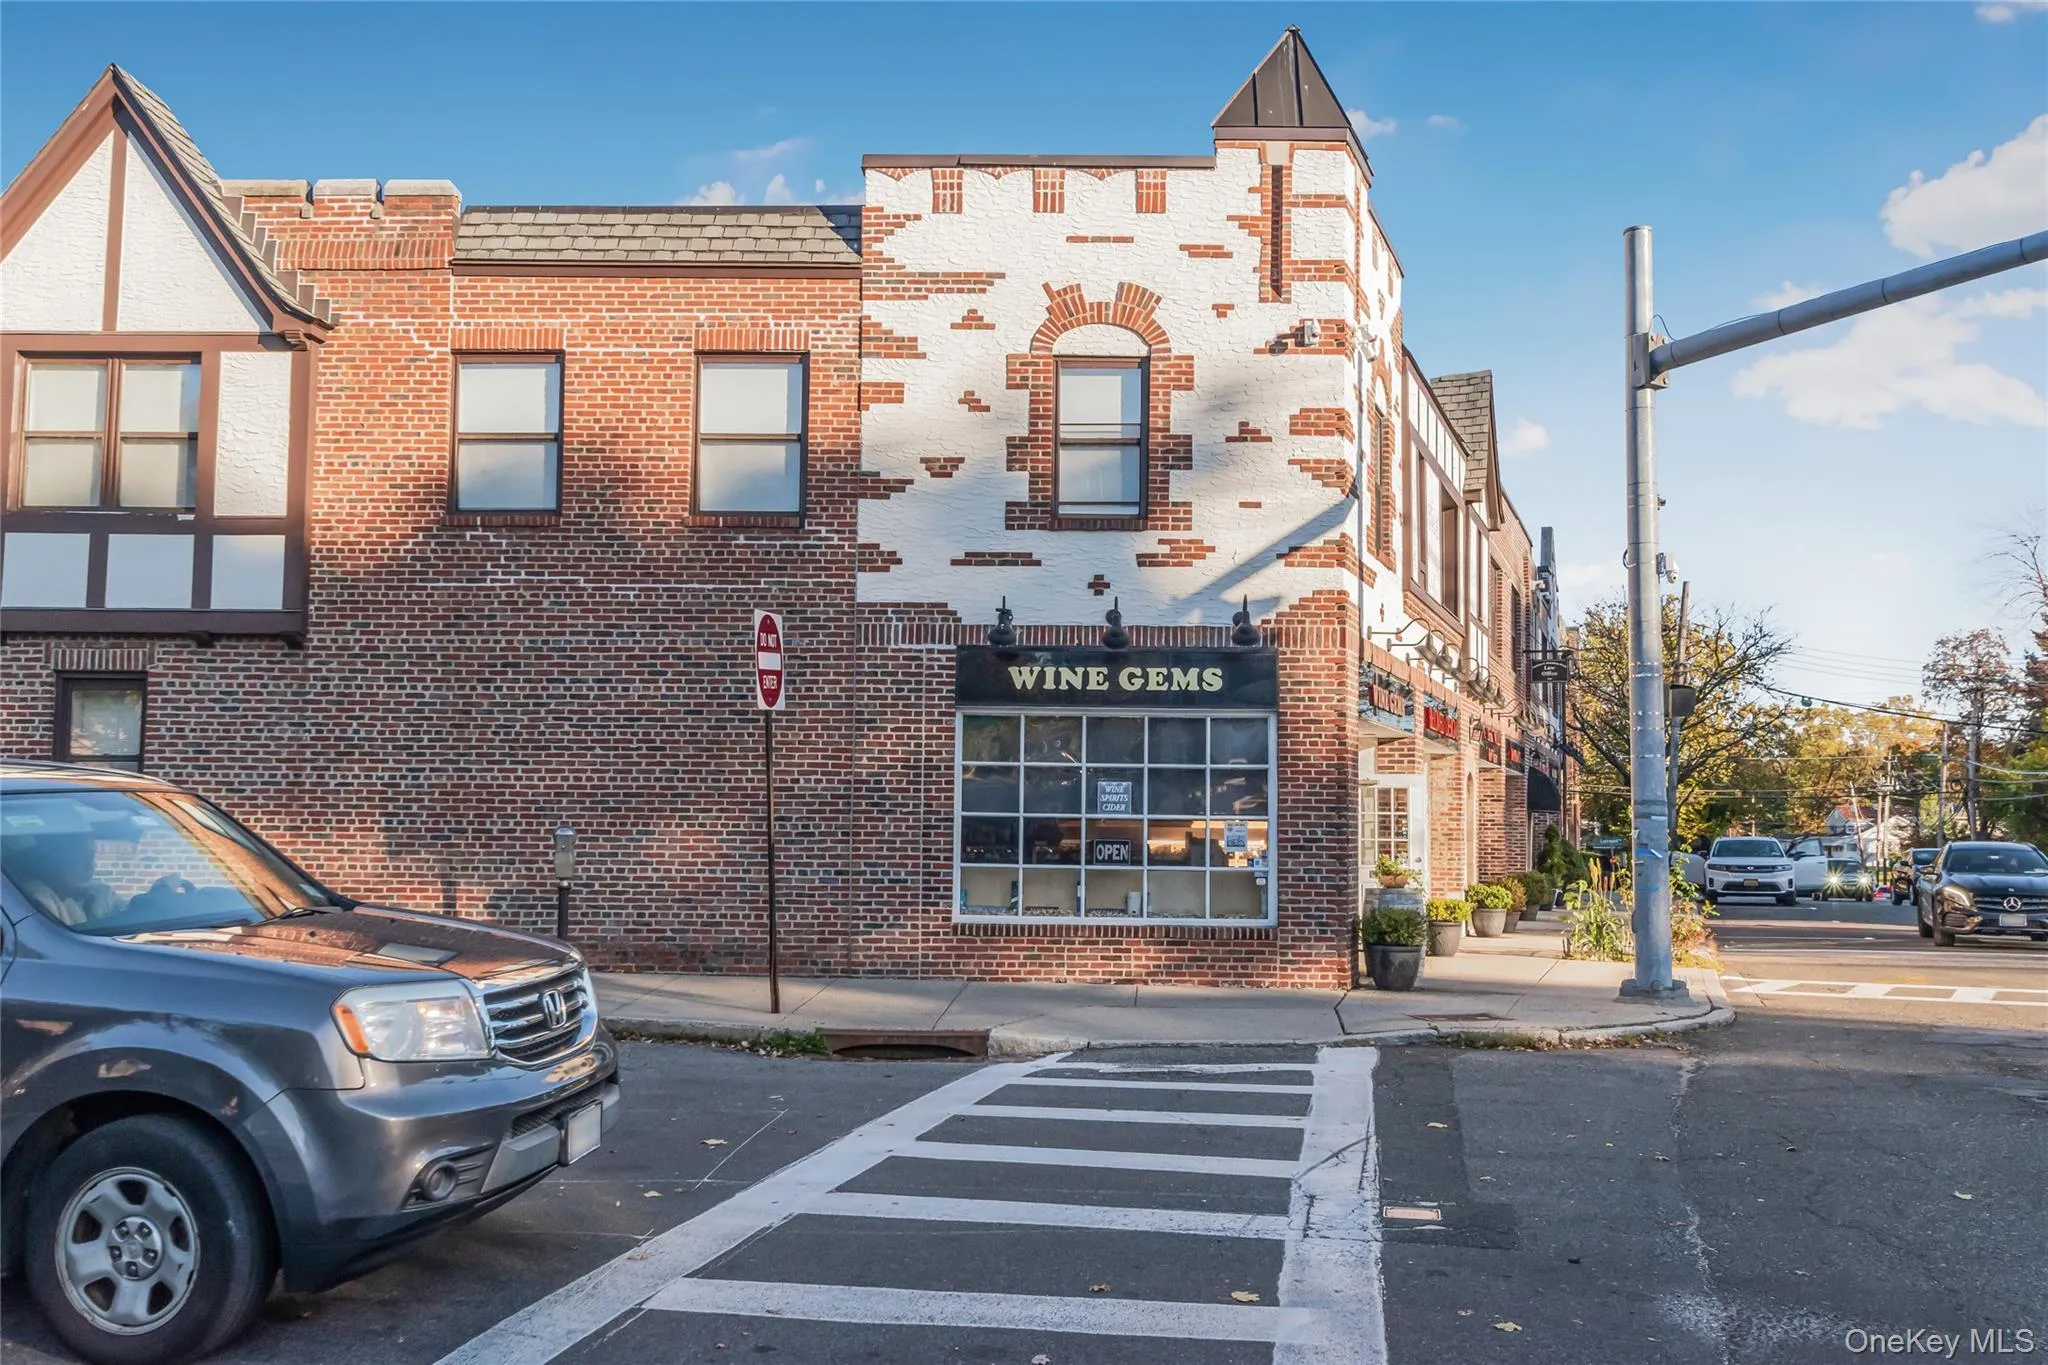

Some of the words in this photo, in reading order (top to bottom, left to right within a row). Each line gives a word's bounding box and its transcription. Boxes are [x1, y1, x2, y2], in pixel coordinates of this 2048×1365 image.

[760, 632, 767, 647] DO
[768, 633, 777, 648] NOT
[763, 675, 777, 690] ENTER
[1008, 666, 1109, 691] WINE
[1118, 666, 1223, 692] GEMS
[1104, 785, 1125, 793] WINE
[1100, 794, 1128, 802] SPIRITS
[1102, 803, 1126, 811] CIDER
[1096, 844, 1128, 861] OPEN
